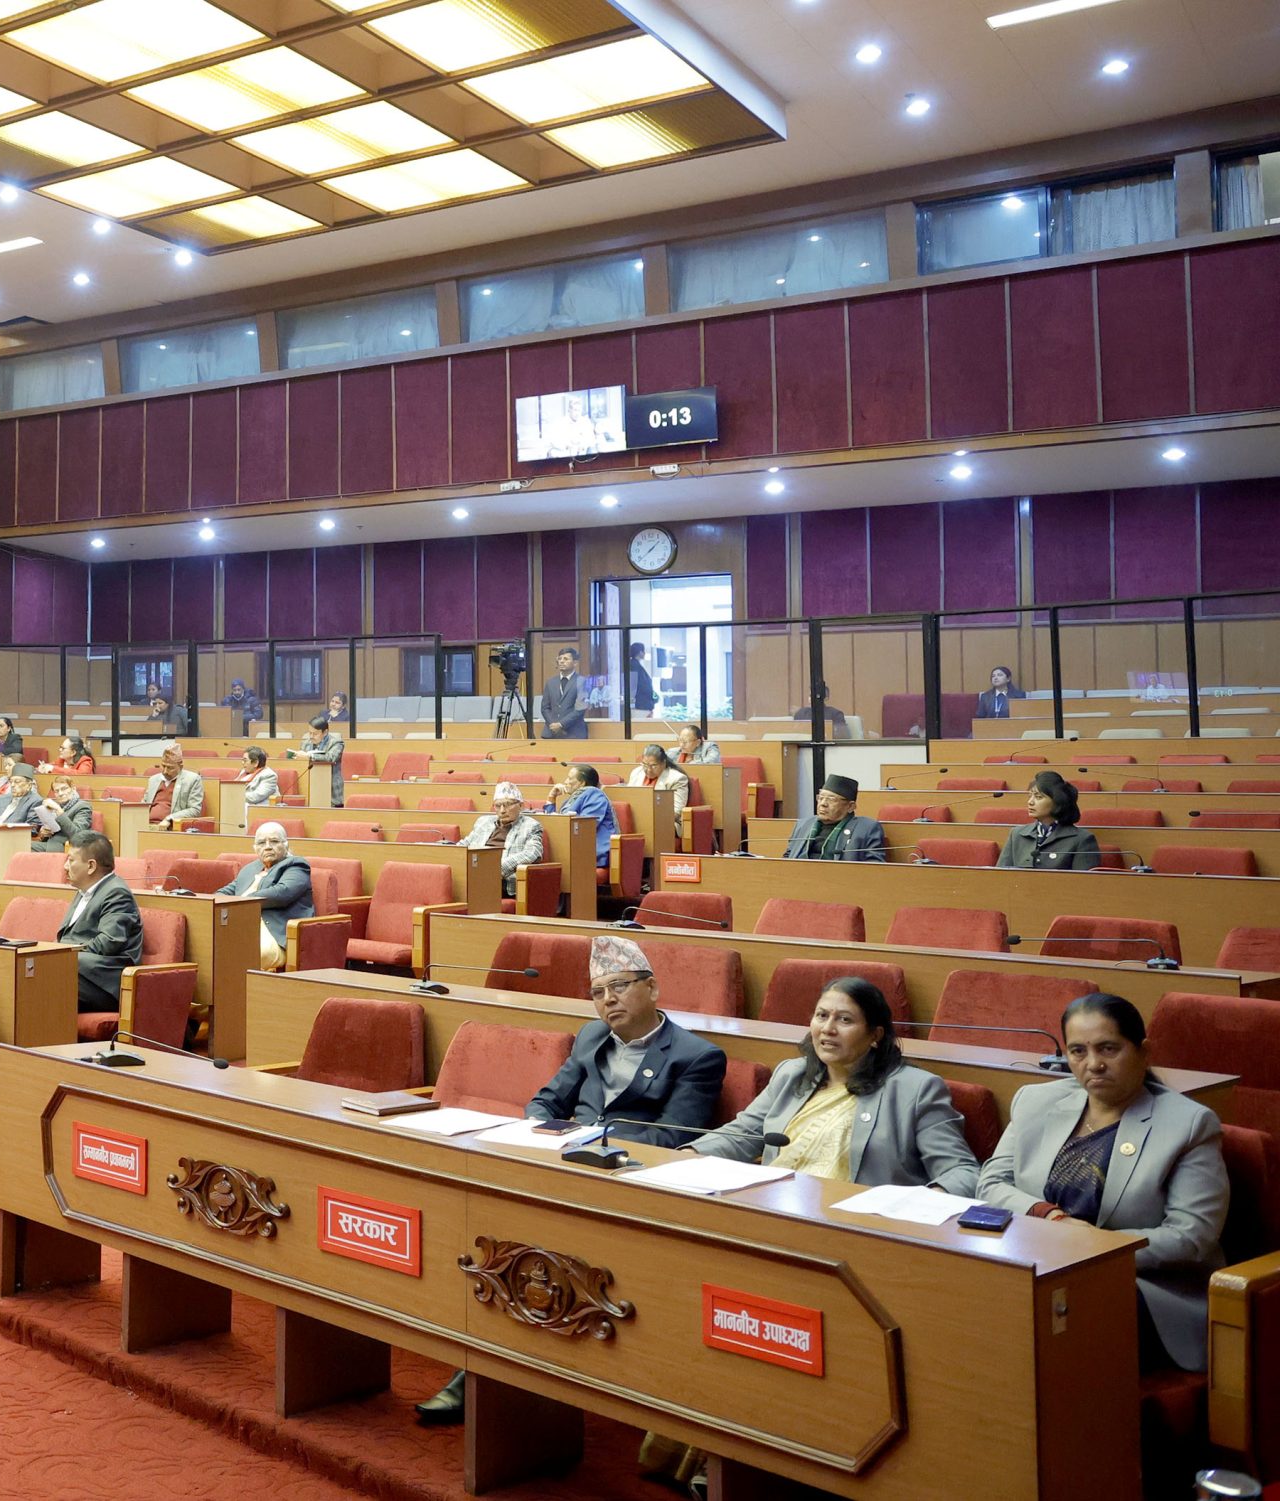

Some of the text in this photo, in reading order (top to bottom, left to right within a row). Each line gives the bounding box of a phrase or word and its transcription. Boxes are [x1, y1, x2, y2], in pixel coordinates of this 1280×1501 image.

[649, 406, 692, 429] 0:13
[338, 1211, 398, 1246] सरकार
[713, 1309, 811, 1352] माननीय उपाध्यक्ष
